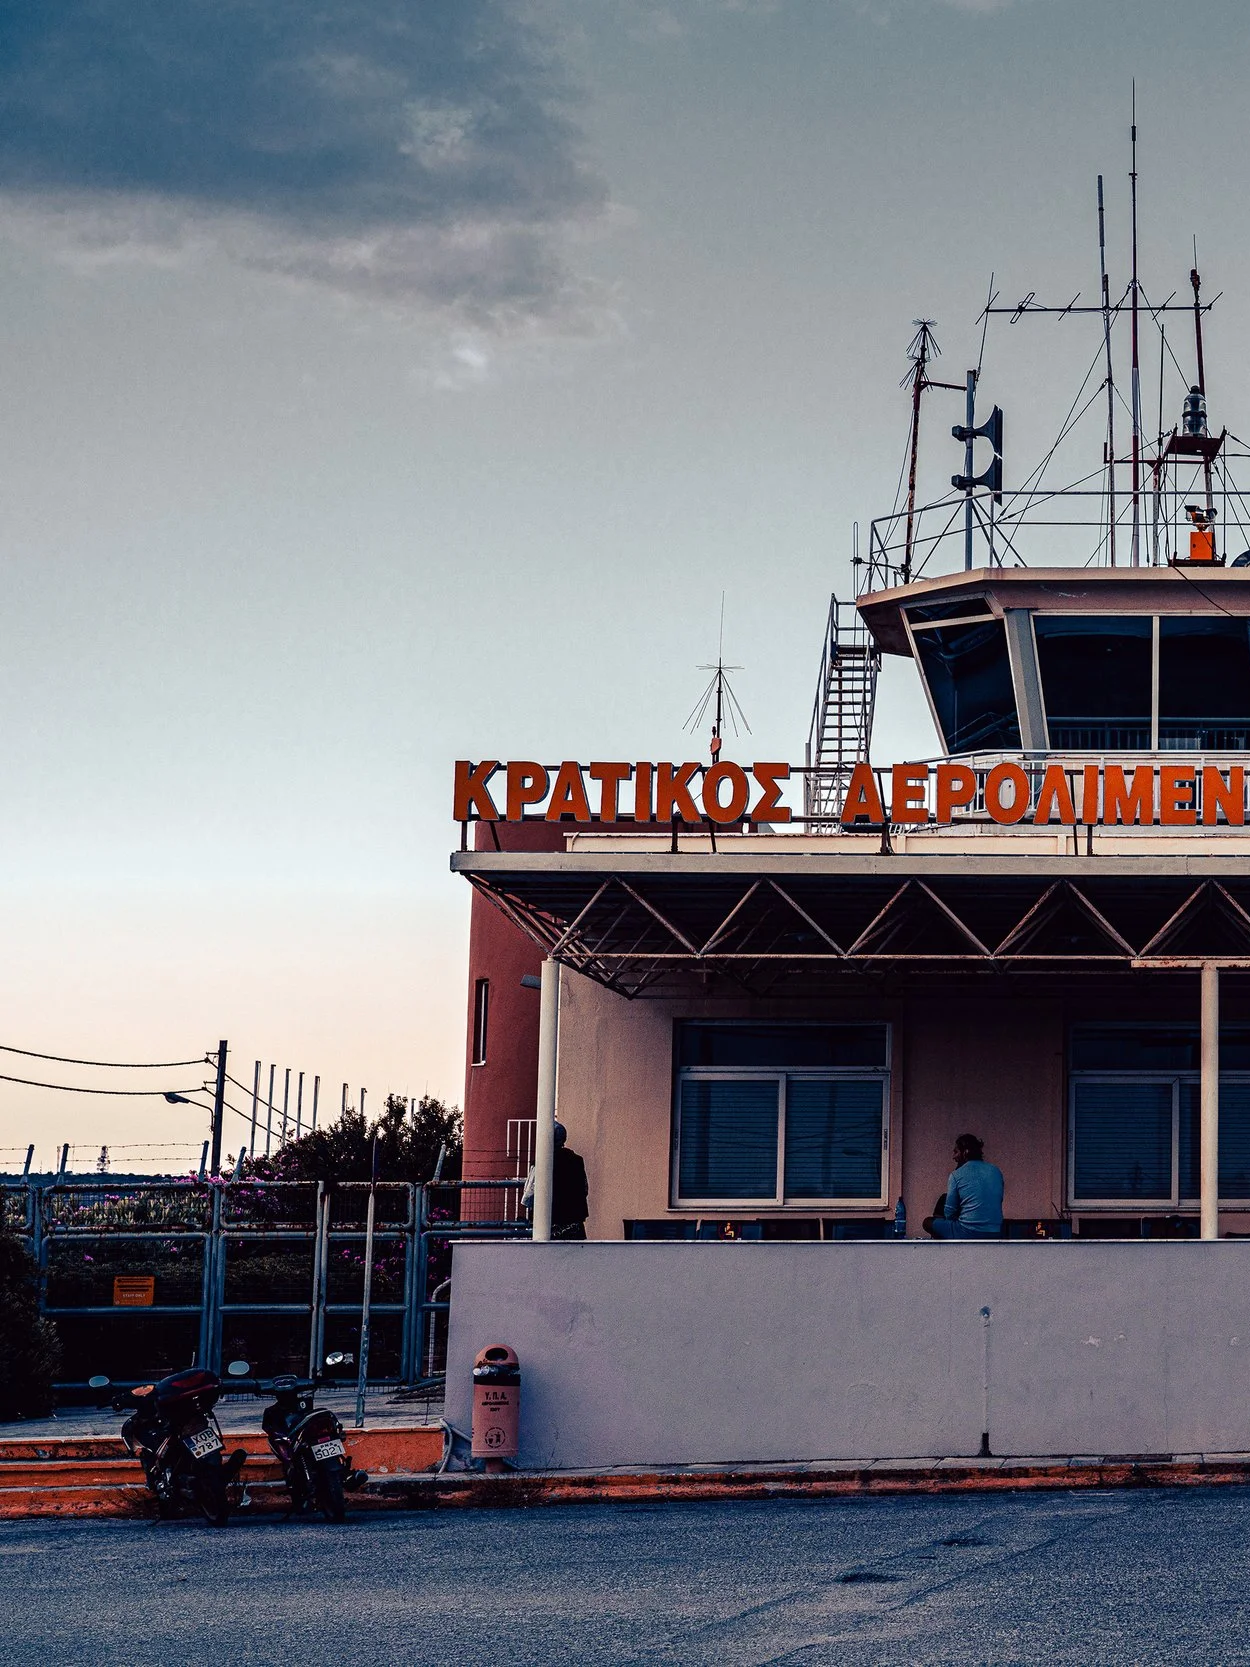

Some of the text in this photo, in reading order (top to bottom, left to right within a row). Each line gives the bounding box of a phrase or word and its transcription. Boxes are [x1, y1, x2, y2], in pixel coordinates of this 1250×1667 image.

[453, 760, 793, 824] ΚΡΑΤΙΚΟΣ
[198, 1438, 219, 1453] 787
[314, 1445, 343, 1460] 5021
